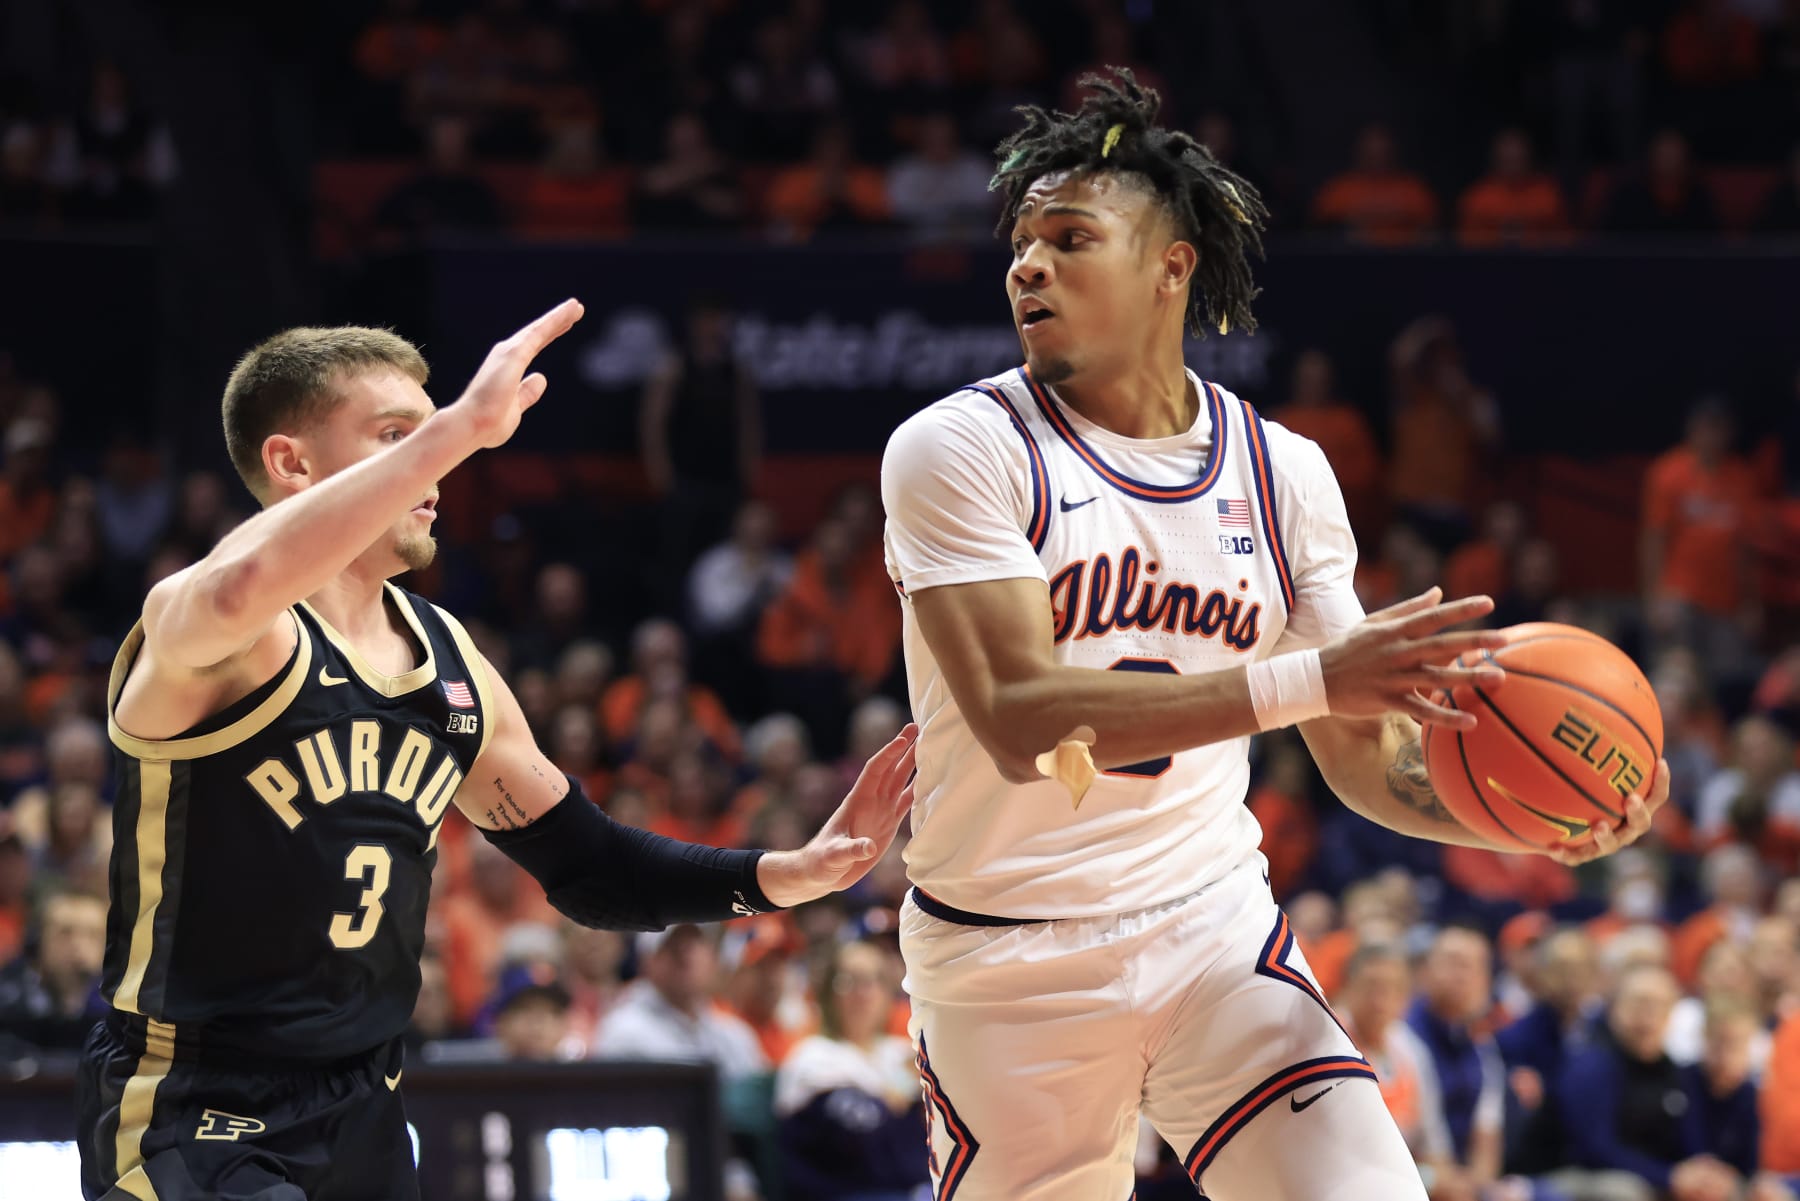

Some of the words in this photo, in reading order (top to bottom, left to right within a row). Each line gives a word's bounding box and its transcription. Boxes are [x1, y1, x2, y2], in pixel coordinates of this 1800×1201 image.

[735, 312, 862, 388] tate
[1050, 545, 1262, 653] Illinois
[1551, 708, 1645, 798] ELITE
[327, 843, 393, 951] 3
[194, 1108, 267, 1143] P
